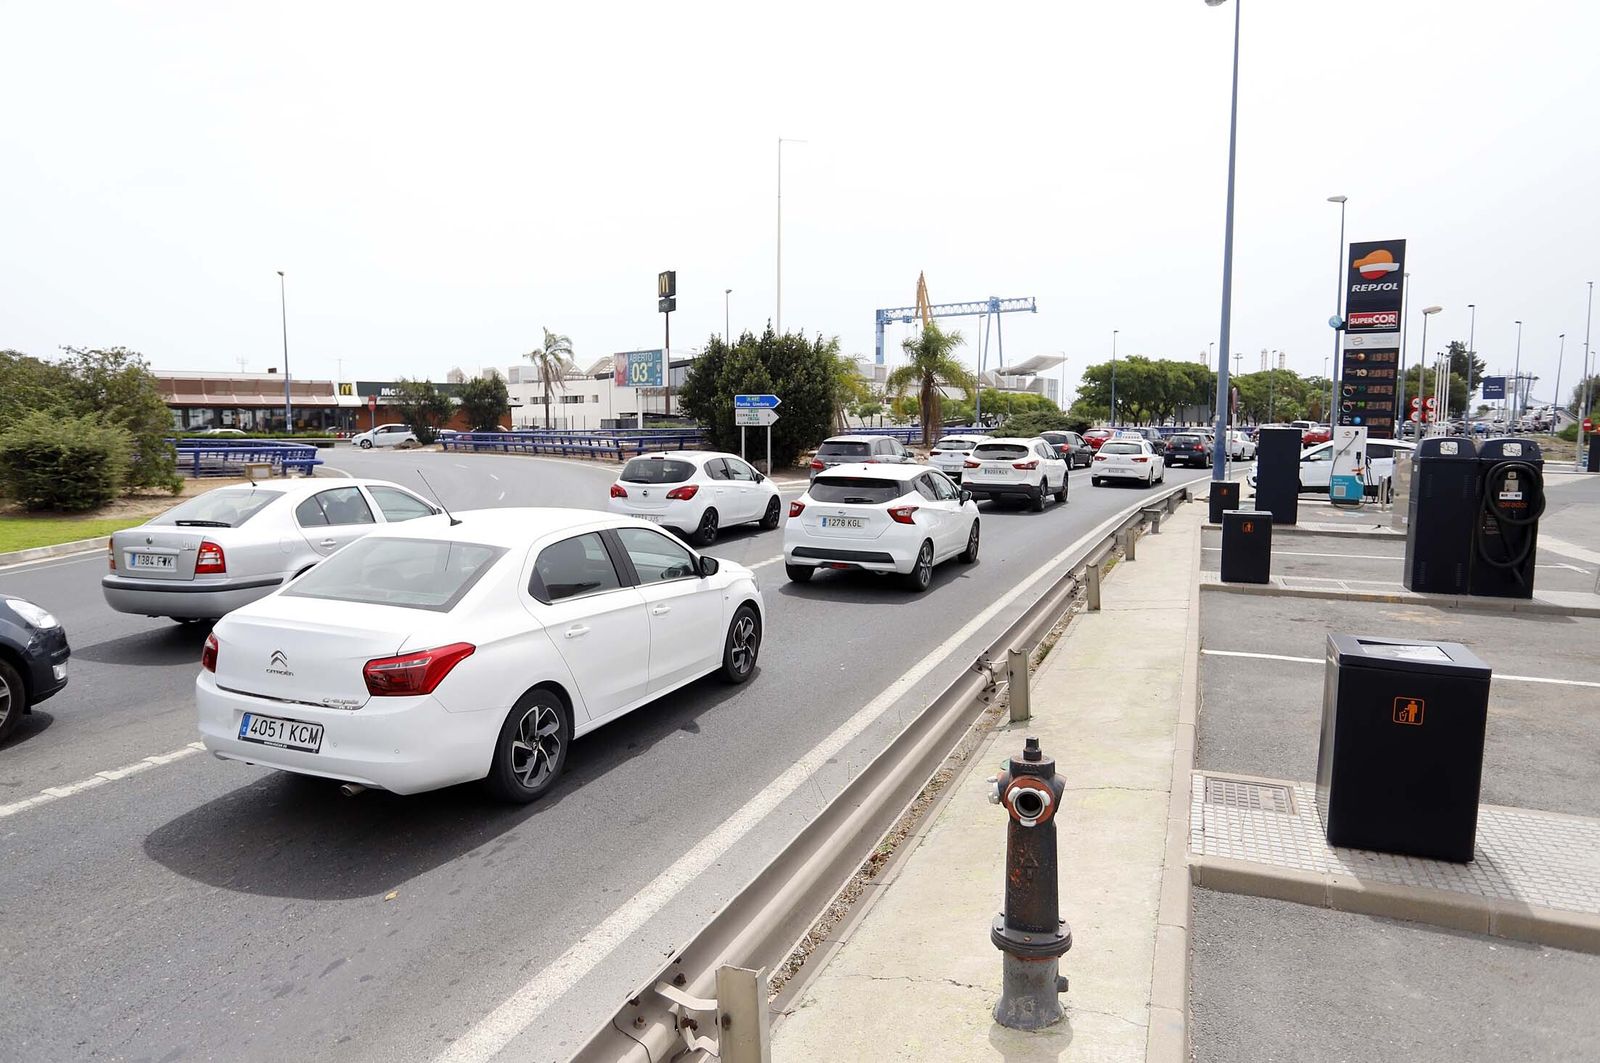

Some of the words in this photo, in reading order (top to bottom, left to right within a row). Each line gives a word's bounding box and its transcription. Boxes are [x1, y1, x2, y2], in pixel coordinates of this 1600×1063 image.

[1351, 282, 1399, 292] REPSOL
[1350, 314, 1396, 324] SUPERCOR
[629, 352, 653, 362] ABIERTO
[631, 362, 648, 382] 03
[828, 519, 846, 527] 1278
[847, 519, 862, 528] KGL
[137, 555, 154, 566] 1384
[250, 718, 285, 740] 4051
[288, 724, 320, 746] KCM
